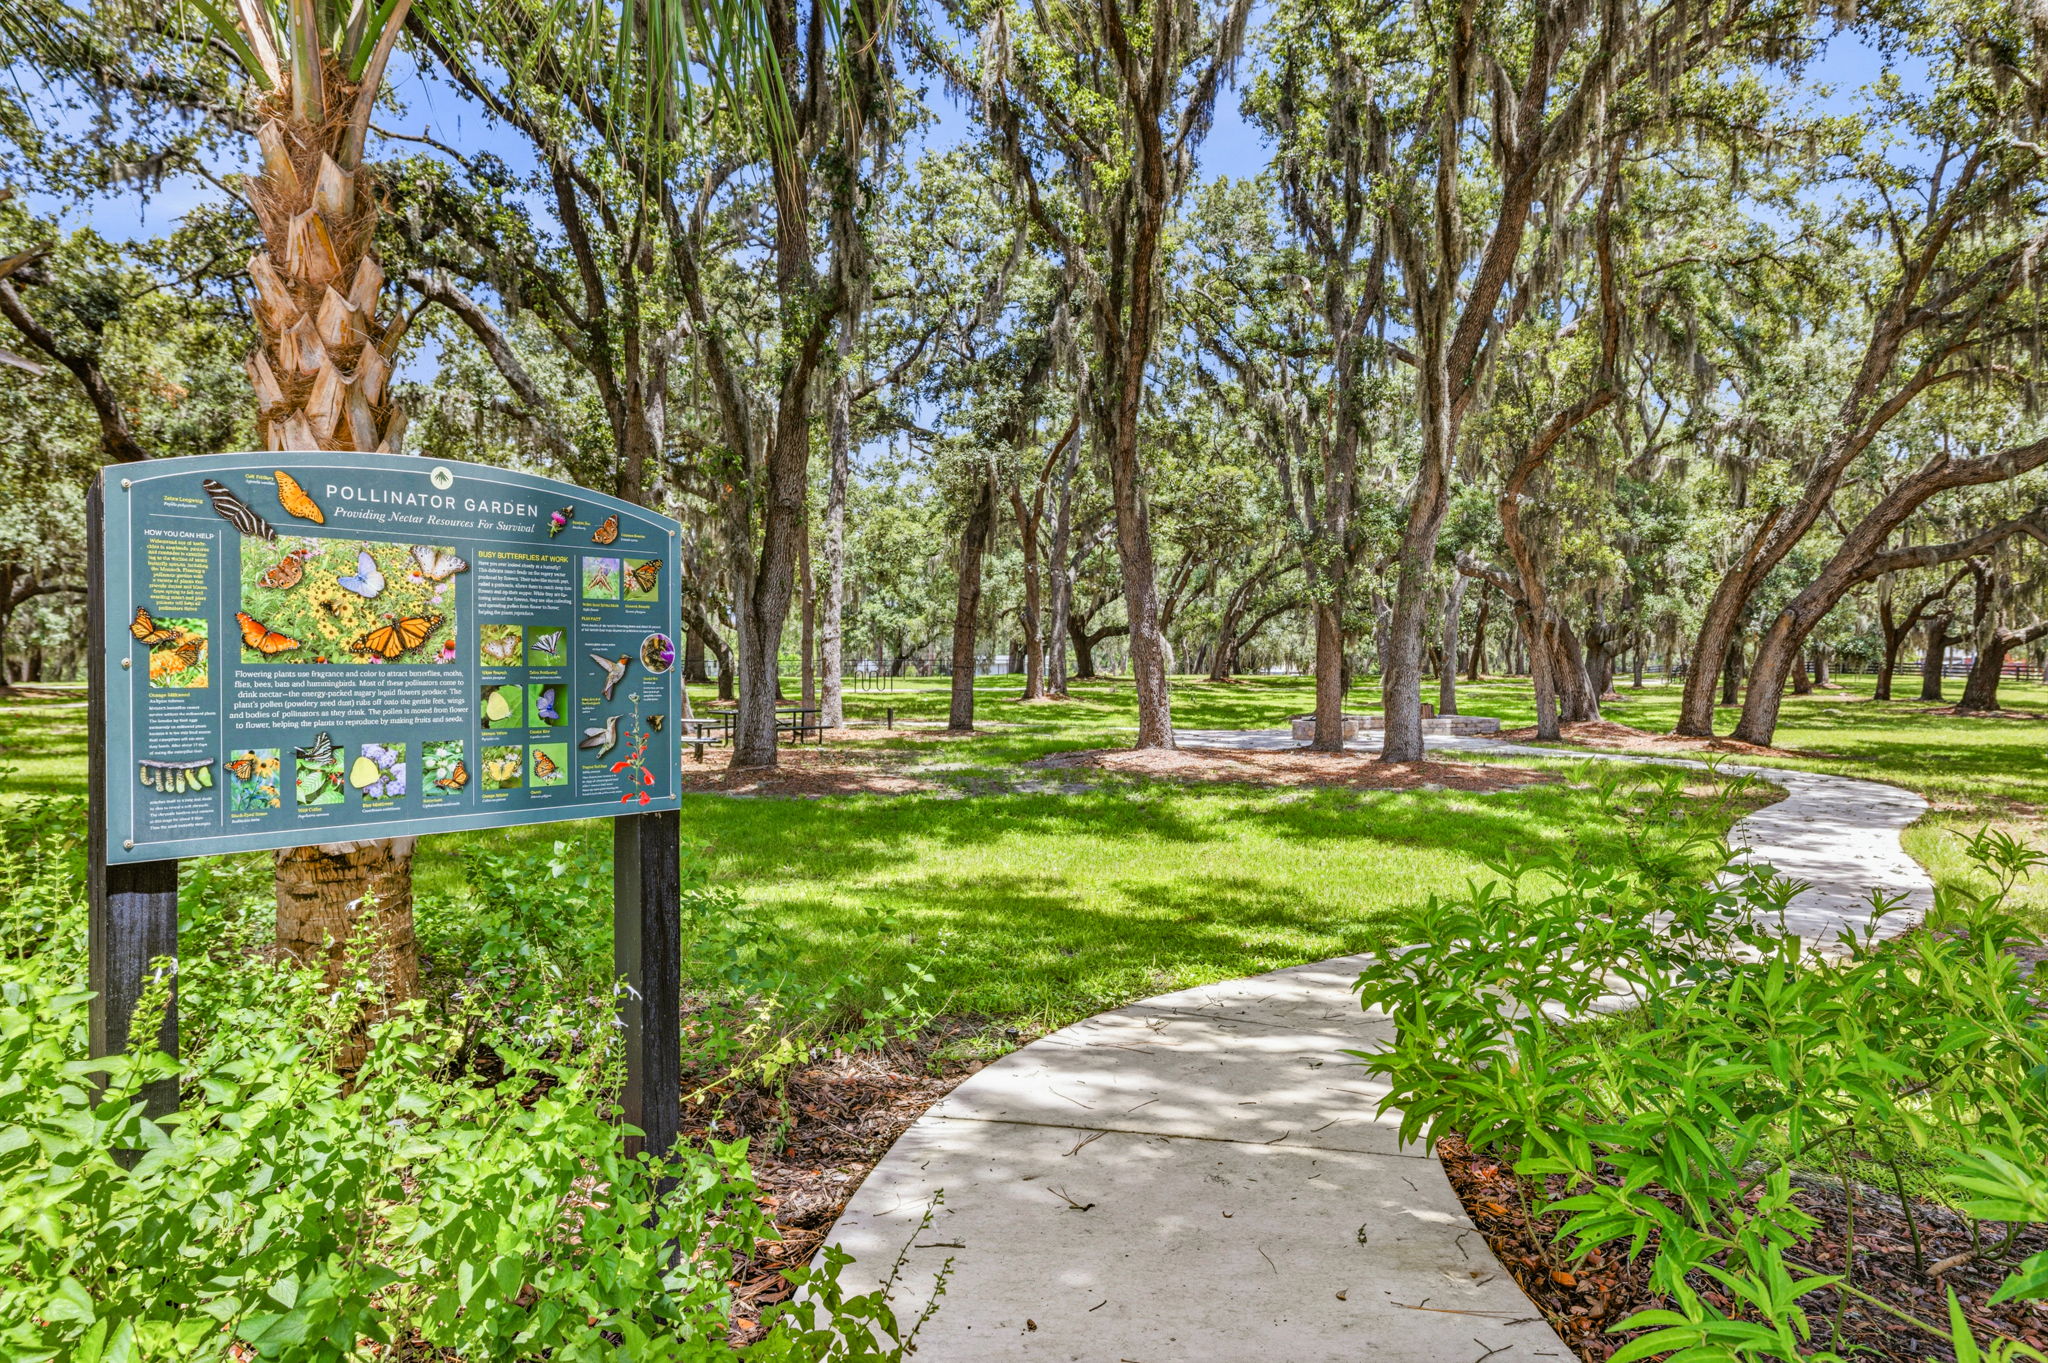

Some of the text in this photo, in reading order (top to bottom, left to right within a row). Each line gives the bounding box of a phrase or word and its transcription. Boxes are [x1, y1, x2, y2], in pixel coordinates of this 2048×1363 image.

[326, 484, 538, 517] POLLINATOR GARDEN
[333, 506, 535, 533] Providing Nectar Resources For Survival
[497, 552, 540, 561] BUTTERFLIES
[235, 670, 272, 679] Flowering
[274, 671, 296, 679] plants
[311, 671, 344, 679] fragrance
[307, 680, 356, 688] hummingbirds.
[301, 689, 353, 698] energy-packed
[377, 689, 396, 697] liquid
[260, 701, 283, 709] pollen
[284, 700, 318, 709] (powdery
[337, 699, 355, 707] dust)
[412, 698, 431, 706] gentle
[282, 710, 320, 719] pollinators
[382, 708, 403, 716] pollen
[313, 720, 335, 728] plants
[345, 718, 379, 726] reproduce
[390, 717, 414, 725] making
